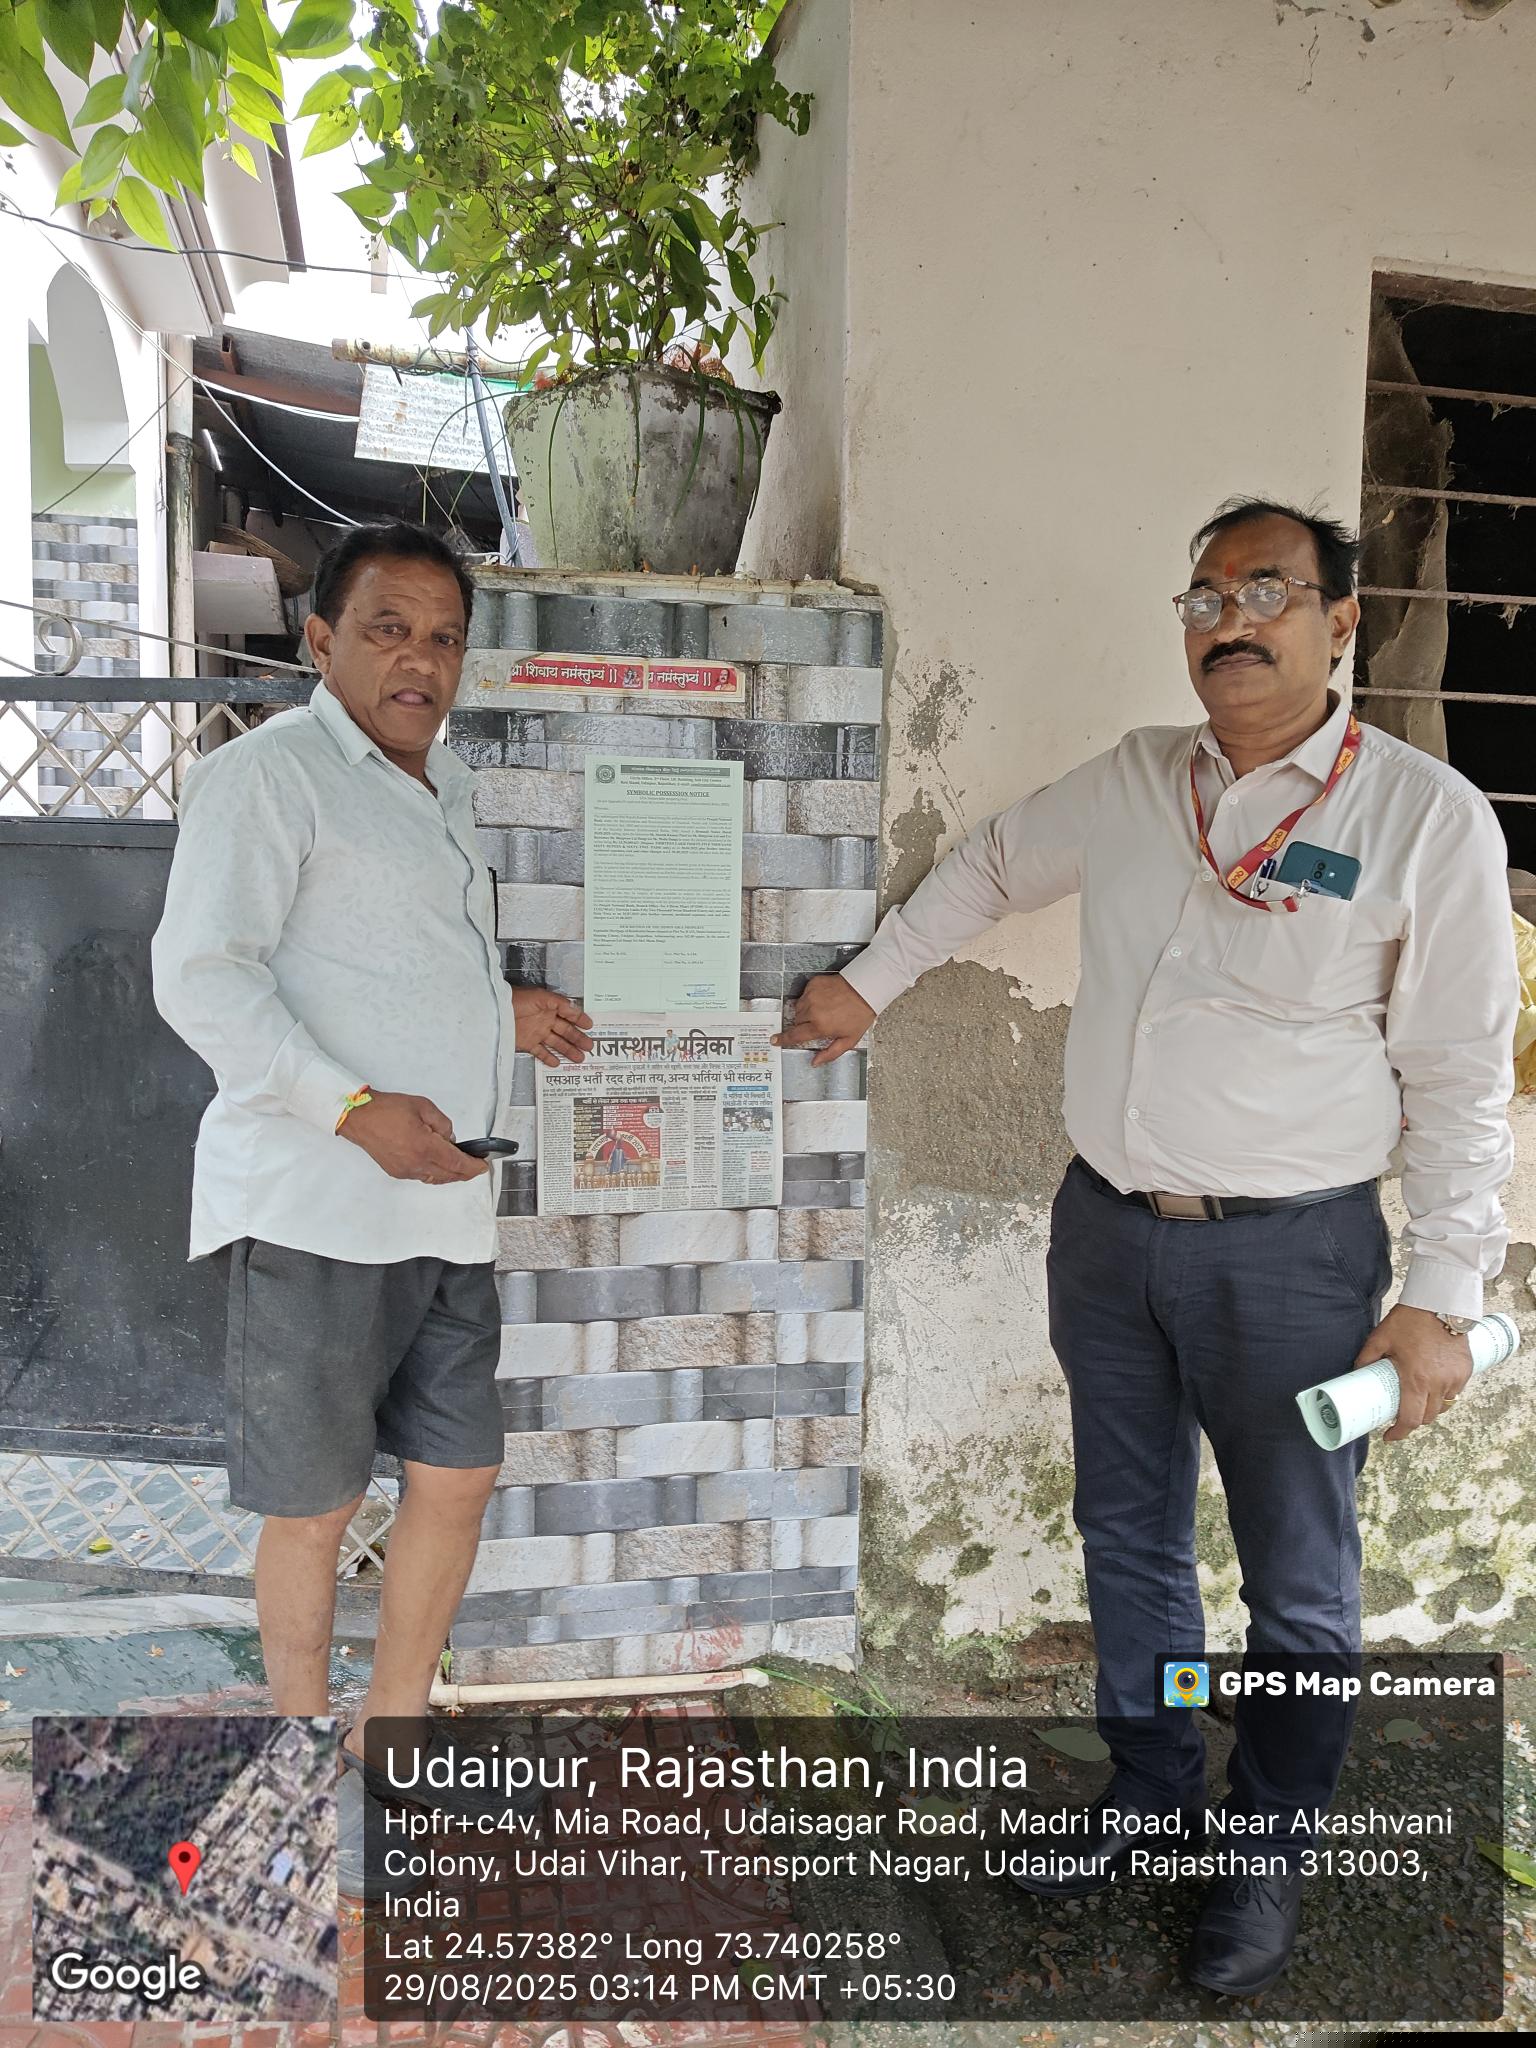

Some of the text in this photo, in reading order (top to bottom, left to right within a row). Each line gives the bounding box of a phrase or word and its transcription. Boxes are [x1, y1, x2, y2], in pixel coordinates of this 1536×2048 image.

[526, 661, 558, 678] शिवाय
[677, 1028, 735, 1057] पत्रिका
[546, 1075, 580, 1087] एसआइ
[583, 1071, 603, 1085] भर्ती
[626, 1071, 646, 1084] होना
[668, 1073, 689, 1083] अन्य
[723, 1069, 736, 1083] भी
[738, 1070, 763, 1083] संकट
[764, 1069, 773, 1082] में
